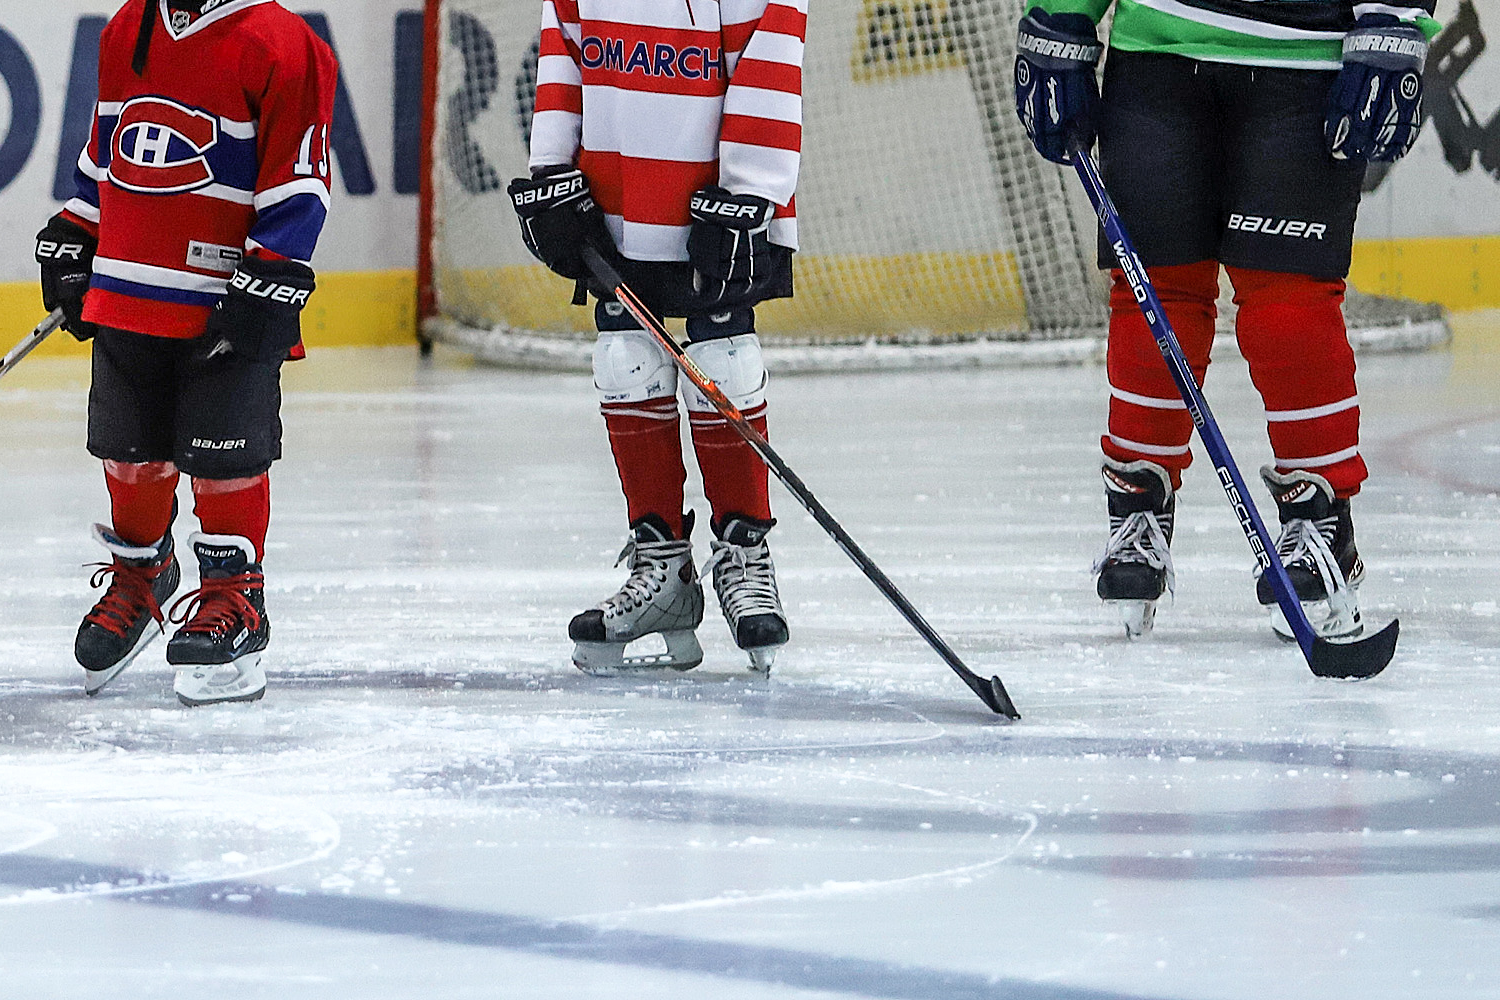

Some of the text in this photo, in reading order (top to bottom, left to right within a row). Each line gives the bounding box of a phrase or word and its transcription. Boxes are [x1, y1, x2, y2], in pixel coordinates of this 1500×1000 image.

[580, 36, 723, 81] OMARCH
[513, 176, 584, 207] BAUER
[1227, 213, 1328, 241] BAUER
[1112, 239, 1149, 304] W250
[191, 437, 247, 450] BAUER
[1280, 482, 1307, 503] CCM
[1216, 465, 1272, 572] FISCHER
[198, 547, 238, 558] BAUER
